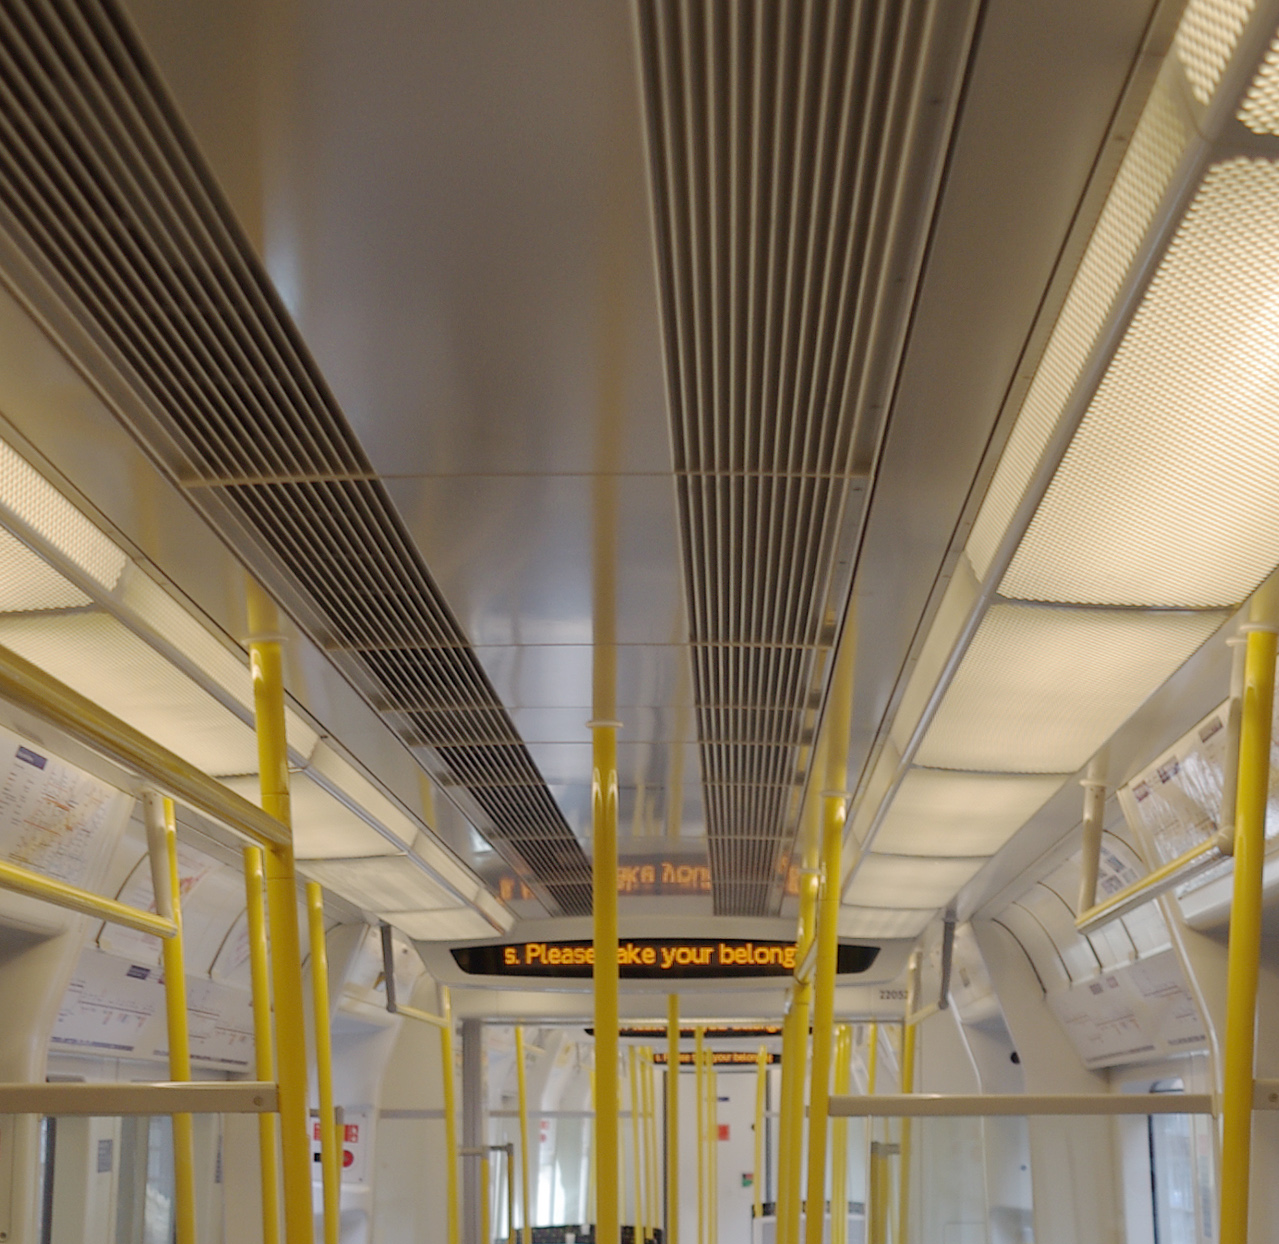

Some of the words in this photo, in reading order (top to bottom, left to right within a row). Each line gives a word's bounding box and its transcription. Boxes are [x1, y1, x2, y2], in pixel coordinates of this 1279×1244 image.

[504, 946, 520, 966] s.
[524, 942, 595, 966] Please
[617, 942, 657, 966] ake
[660, 945, 714, 970] your
[718, 942, 798, 970] belong
